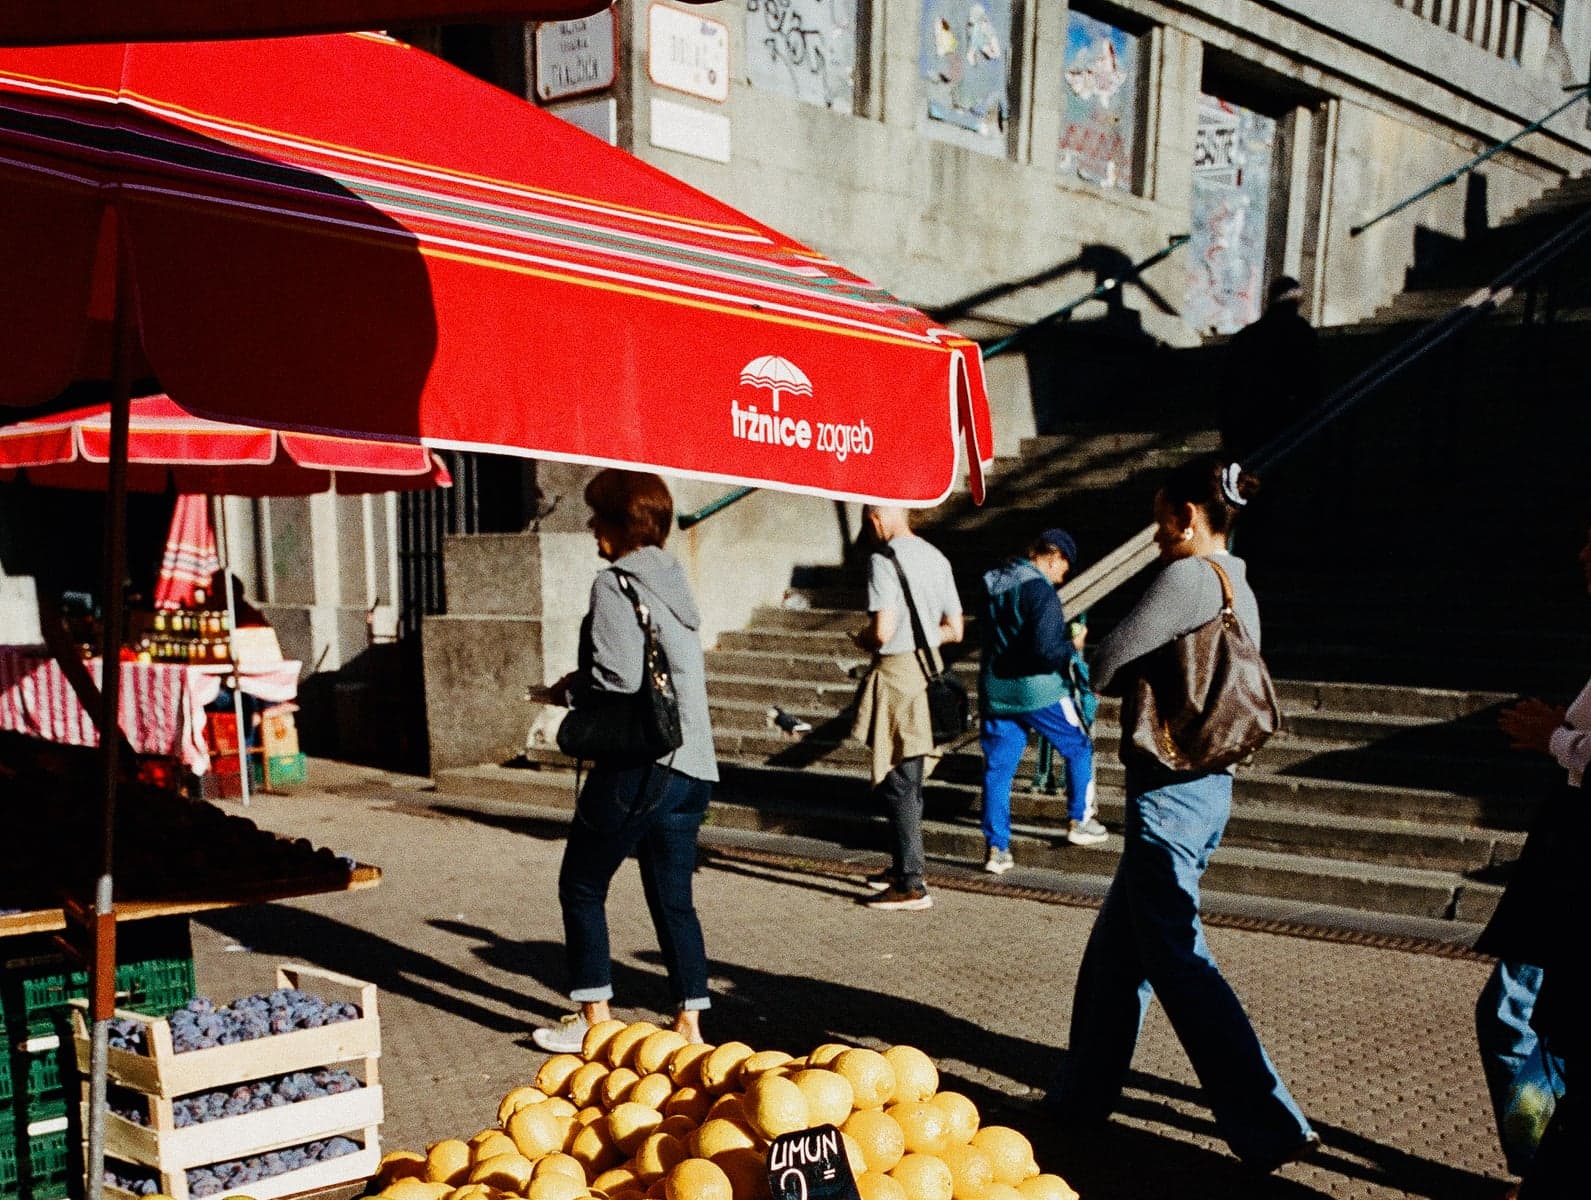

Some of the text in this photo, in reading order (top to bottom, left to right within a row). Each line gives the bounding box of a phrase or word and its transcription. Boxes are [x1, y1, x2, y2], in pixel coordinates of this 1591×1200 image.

[731, 400, 873, 462] tržnice zagreb
[770, 1130, 838, 1171] LIMUN
